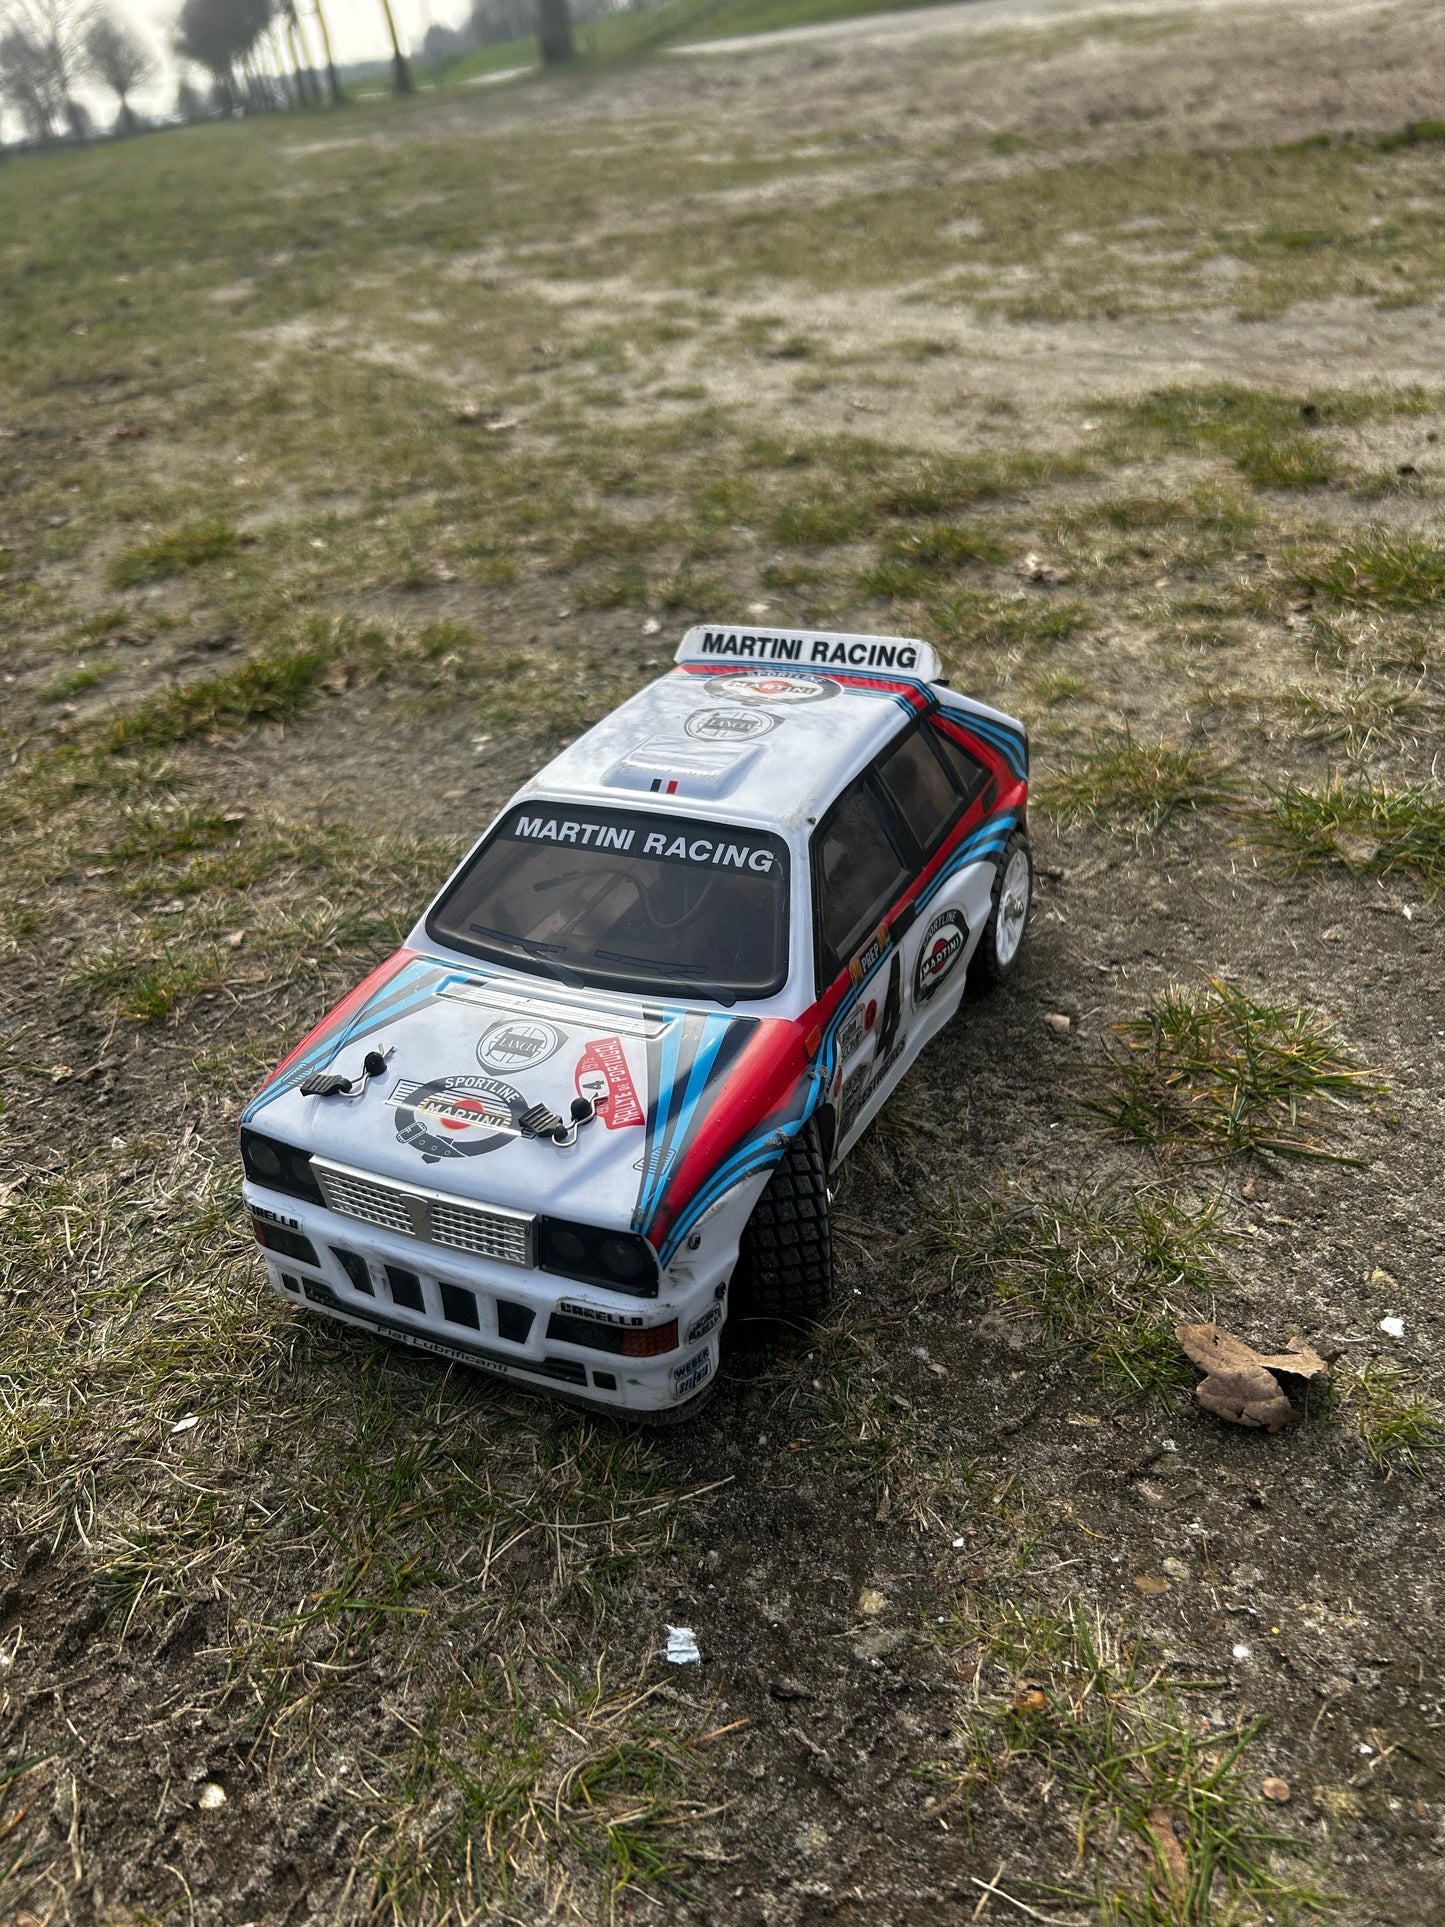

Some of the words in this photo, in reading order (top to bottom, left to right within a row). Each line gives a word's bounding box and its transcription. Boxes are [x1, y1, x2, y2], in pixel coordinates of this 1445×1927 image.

[702, 633, 802, 660] MARTINI
[810, 641, 916, 668] RACING
[731, 681, 817, 694] MARTINI
[746, 671, 828, 684] SPORTLINE
[514, 817, 636, 850] MARTINI
[643, 832, 775, 872] RACING
[921, 935, 960, 981] MARTINI
[500, 1037, 538, 1053] LANCIA
[592, 1040, 628, 1083] PORTUGAL
[444, 1077, 520, 1103] SPORTLINE
[582, 1080, 605, 1090] 4
[426, 1102, 504, 1127] MARTINI
[612, 1091, 641, 1126] RALLYE
[560, 1302, 643, 1327] CARELLO
[377, 1325, 408, 1341] Fiat
[413, 1337, 508, 1373] Lubrificanti
[675, 1348, 709, 1377] WEBER
